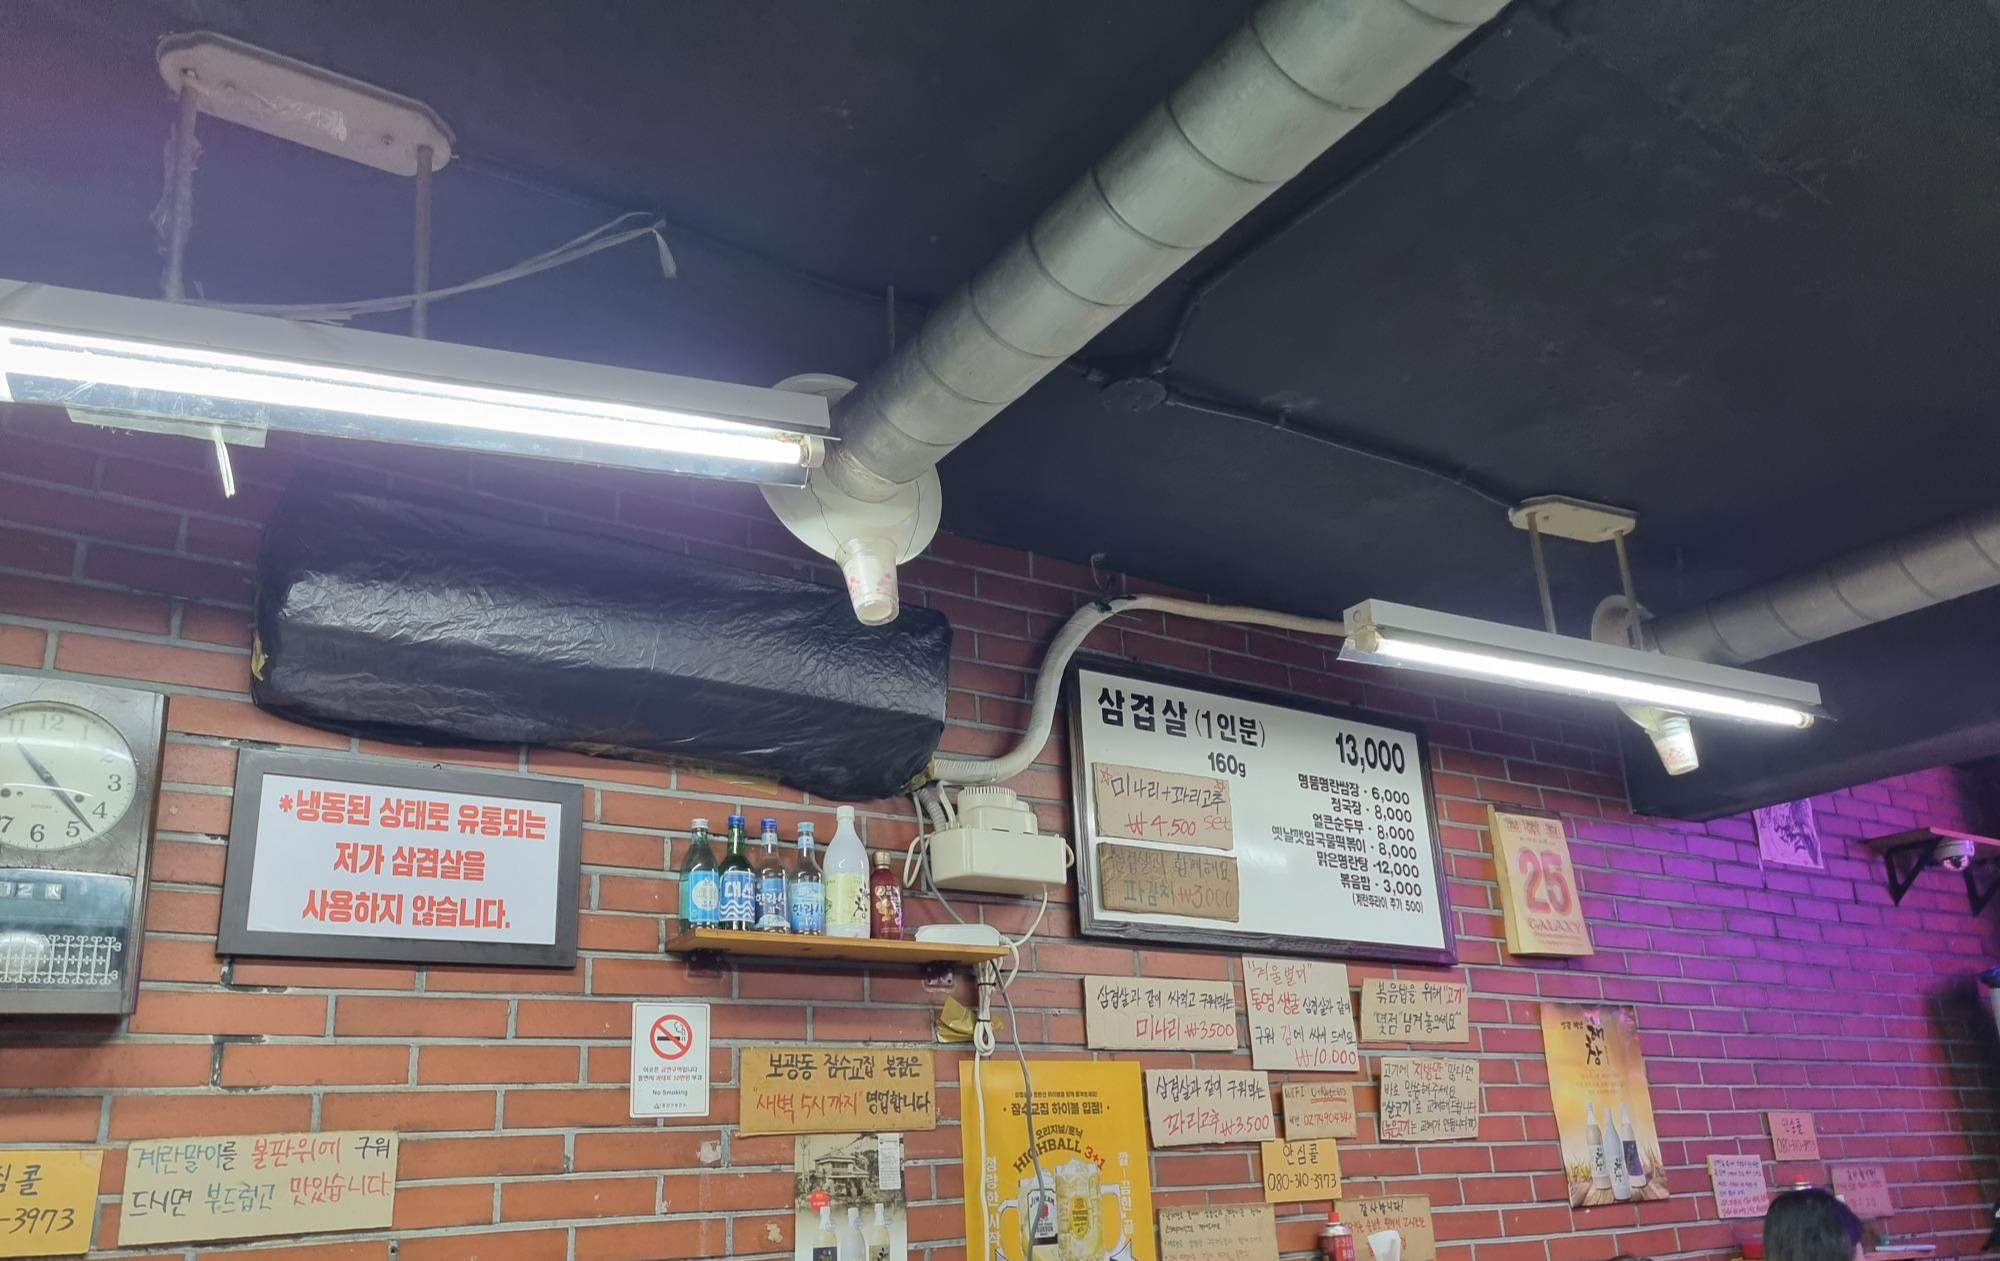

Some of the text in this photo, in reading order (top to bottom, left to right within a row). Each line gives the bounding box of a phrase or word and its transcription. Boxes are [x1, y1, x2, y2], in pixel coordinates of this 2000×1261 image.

[40, 713, 65, 731] 12
[1097, 687, 1266, 748] 삼겹살 (1인분)
[1207, 751, 1247, 778] 160g
[1335, 731, 1406, 774] 13,000
[107, 774, 122, 792] 3
[1298, 773, 1410, 805] 명품명란쌈장 6,000
[92, 801, 108, 819] 4
[379, 797, 450, 832] 상태로
[457, 804, 547, 840] 유통되는
[1374, 805, 1412, 823] 8,000
[0, 815, 15, 833] 7
[30, 824, 45, 842] 6
[66, 820, 80, 838] 5
[1312, 813, 1415, 842] 얼큰순두부 8,000
[1271, 825, 1417, 860] 옛날깻잎국물떡볶이 8,000
[333, 842, 486, 881] 저가 삼겹살을
[1317, 851, 1419, 878] 맑은명란탕 12,000
[724, 880, 754, 899] 대선
[1340, 873, 1422, 897] 볶음밥 3,000
[1518, 846, 1573, 917] 25
[302, 889, 511, 929] 사용하지 않습니다.
[1352, 893, 1424, 914] (계란후라이 추가 500)
[1097, 985, 1141, 1009] 삼겹살과
[1145, 989, 1162, 1009] 같이
[1199, 991, 1235, 1013] 구워먹는
[1250, 987, 1275, 1013] 통영
[1278, 991, 1300, 1015] 생굴
[1376, 981, 1416, 1004] 볶음밥을
[1422, 982, 1442, 1005] 위해
[1136, 1014, 1180, 1042] 미나리
[1255, 1025, 1275, 1045] 구워
[1331, 1027, 1357, 1045] 드세요
[766, 1053, 923, 1081] 보광동 잠수교집 본점은
[1384, 1063, 1409, 1078] 고기에
[662, 1089, 688, 1097] Smoking
[1156, 1073, 1266, 1103] 삼겹살과 같이 구워먹는
[1285, 1086, 1305, 1098] WIFI
[1384, 1083, 1400, 1096] 바로
[866, 1089, 931, 1115] 영업합니다
[1051, 1102, 1080, 1115] 하이볼
[1082, 1101, 1104, 1115] 입점!
[1163, 1106, 1220, 1136] 꽈리고추
[133, 1136, 391, 1175] 계란말이를 불판위에 구워
[1084, 1146, 1106, 1171] 3+1
[1282, 1143, 1319, 1166] 안심콜
[129, 1171, 391, 1217] 드시면 부드럽고 맛있습니다.
[1267, 1172, 1337, 1191] 080-310-3973
[1359, 1199, 1404, 1217] 감사합니다!
